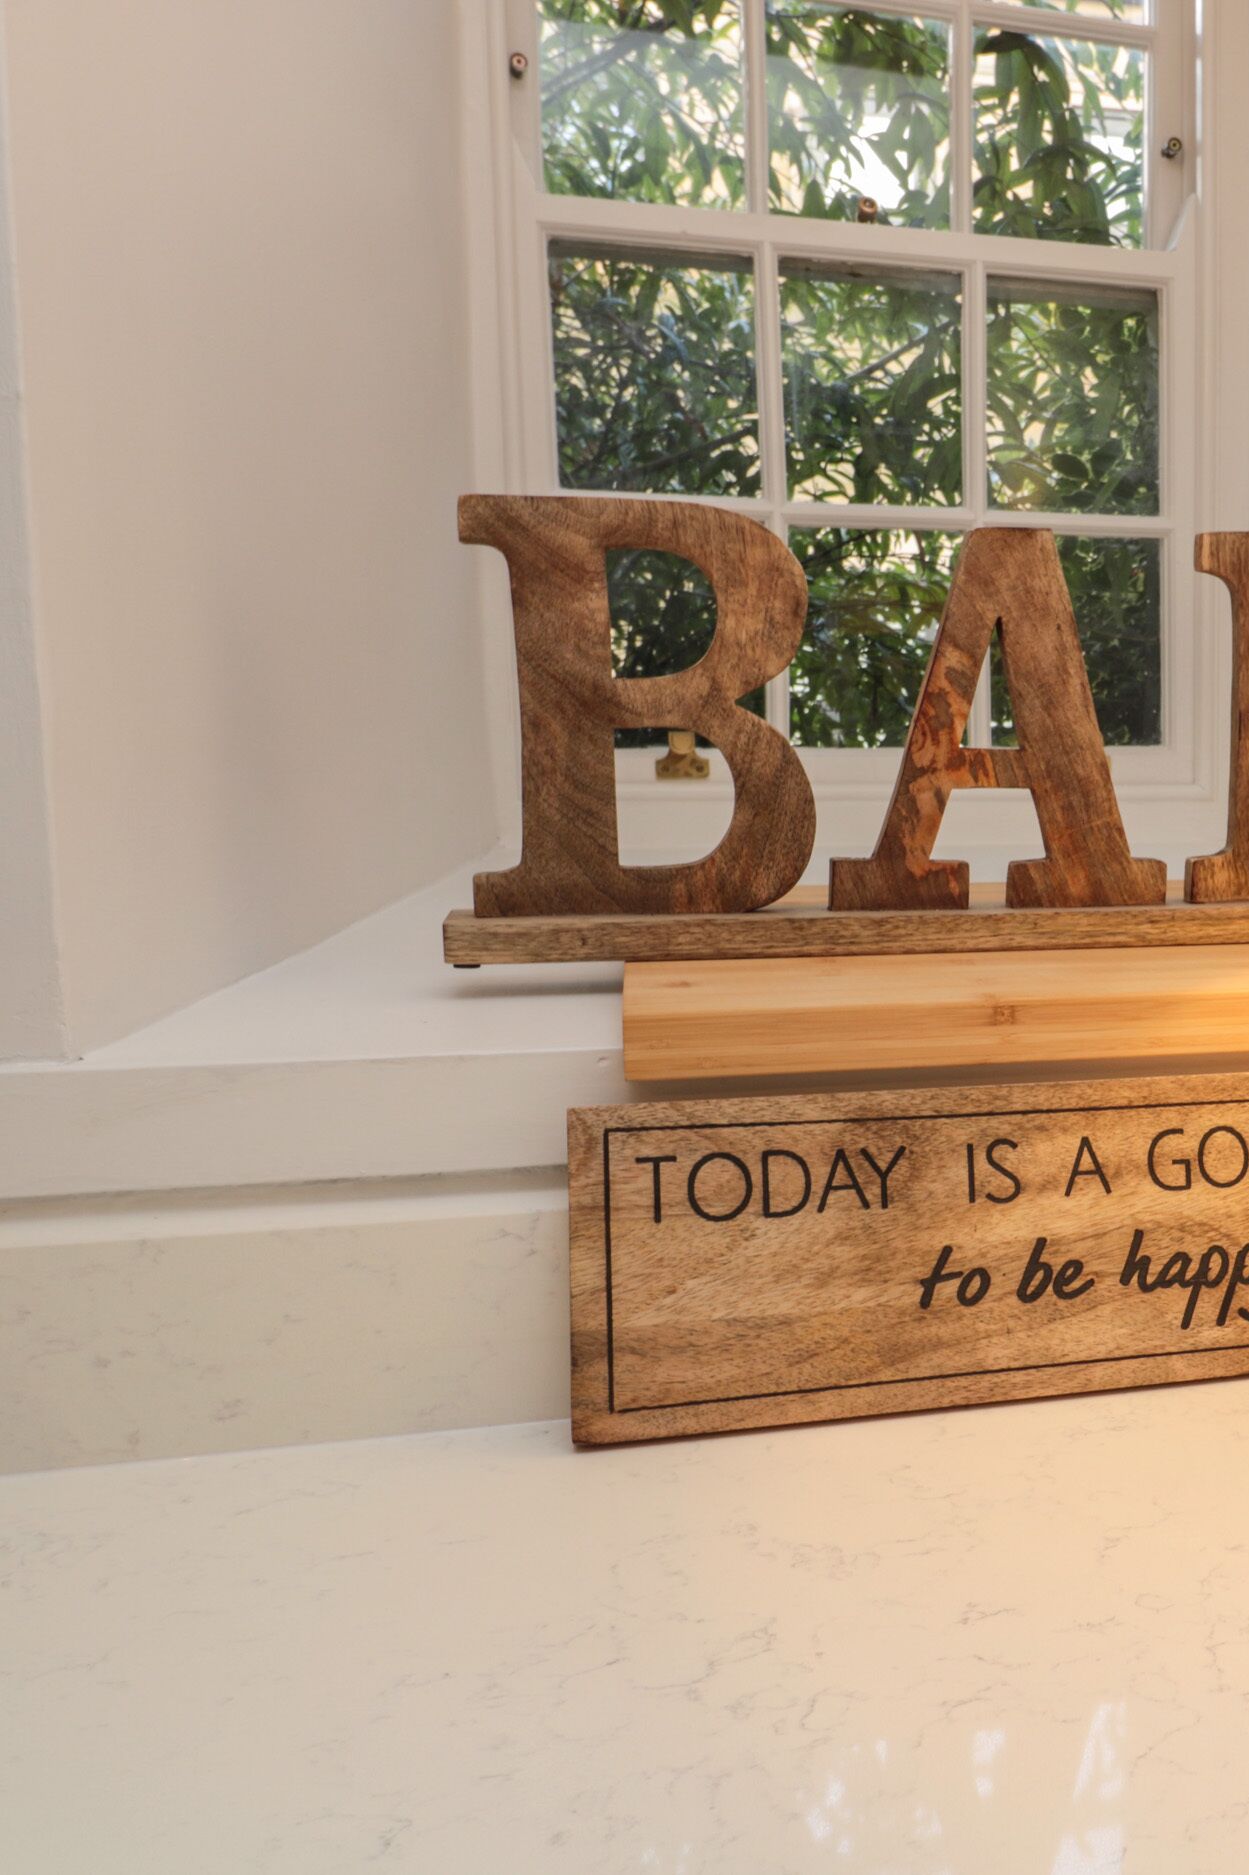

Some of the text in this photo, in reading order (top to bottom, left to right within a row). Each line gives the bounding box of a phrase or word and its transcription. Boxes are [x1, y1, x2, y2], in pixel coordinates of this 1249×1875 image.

[634, 1144, 907, 1224] TODAY
[966, 1137, 1022, 1204] IS
[1064, 1136, 1112, 1197] A
[919, 1244, 992, 1310] to
[1015, 1236, 1096, 1304] be
